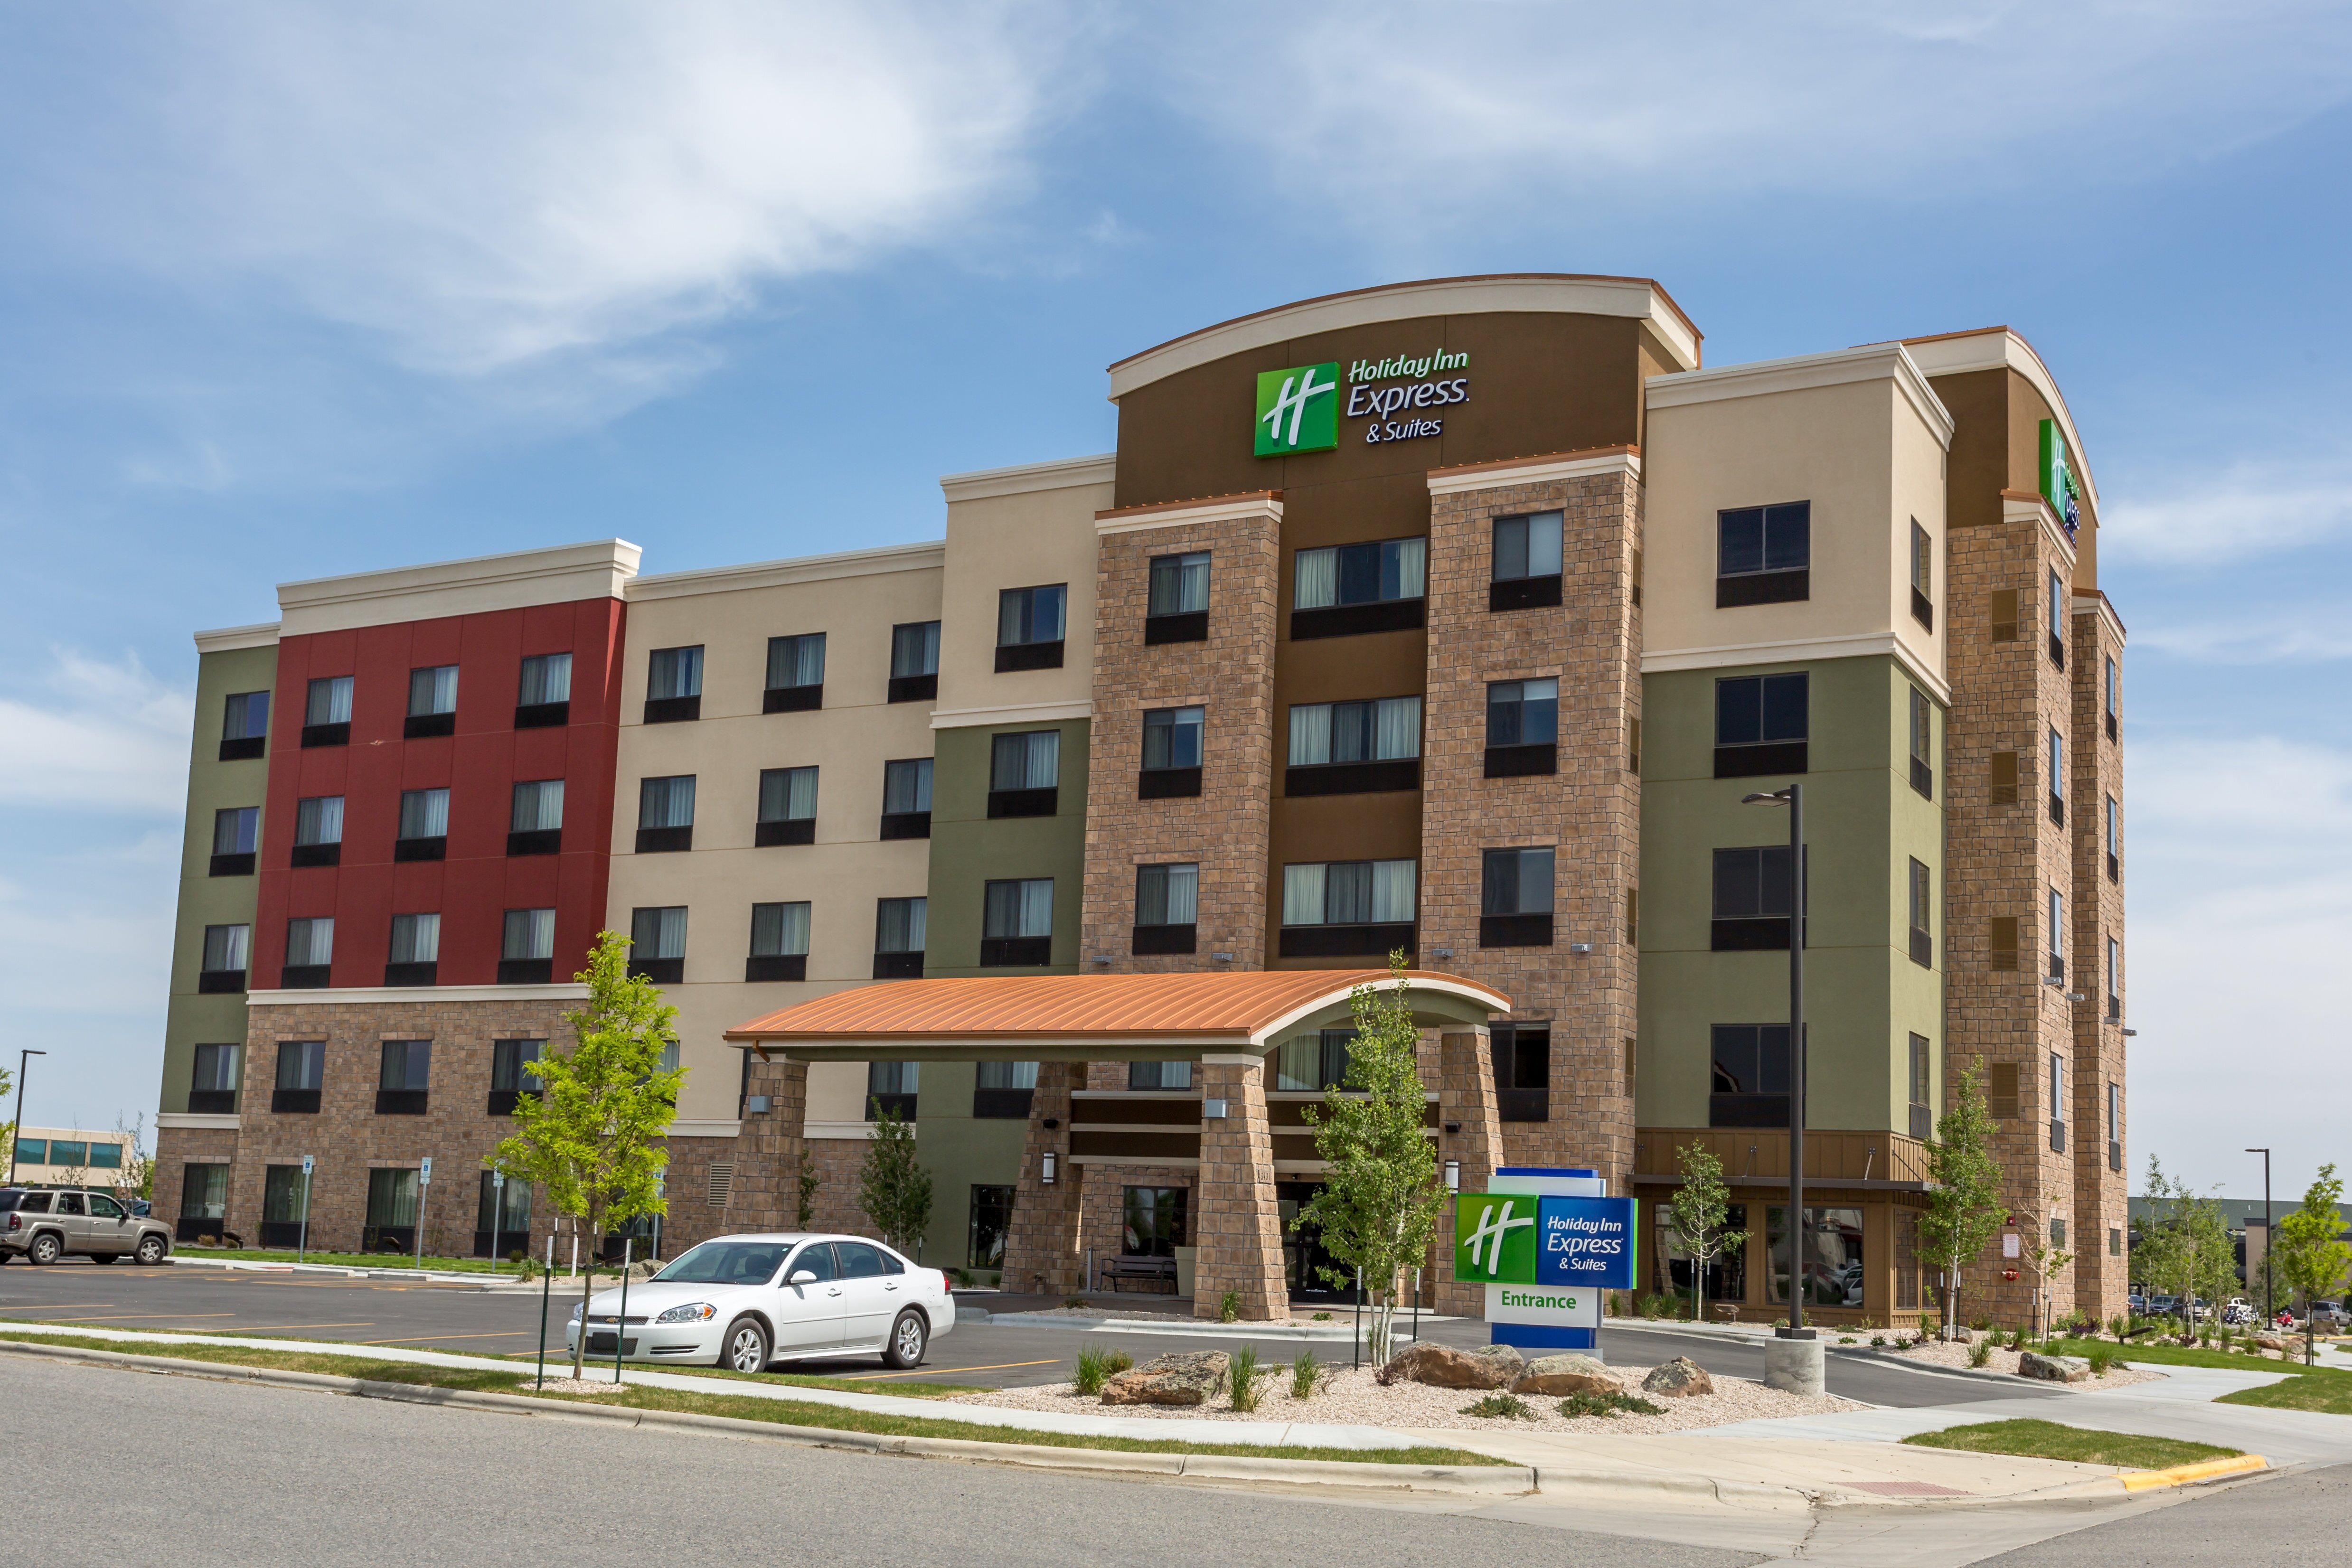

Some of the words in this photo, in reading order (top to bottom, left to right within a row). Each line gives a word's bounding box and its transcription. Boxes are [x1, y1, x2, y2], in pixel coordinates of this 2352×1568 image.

[1348, 354, 1430, 383] Holiday
[1433, 348, 1470, 371] Inn
[1347, 379, 1468, 421] Express
[1366, 423, 1381, 444] &
[1383, 419, 1443, 441] Suites
[1547, 1216, 1599, 1234] Holiday
[1600, 1218, 1622, 1232] Inn
[1547, 1233, 1621, 1257] Express
[1559, 1258, 1568, 1269] &
[1571, 1258, 1607, 1270] Suites
[1502, 1290, 1577, 1309] Entrance
